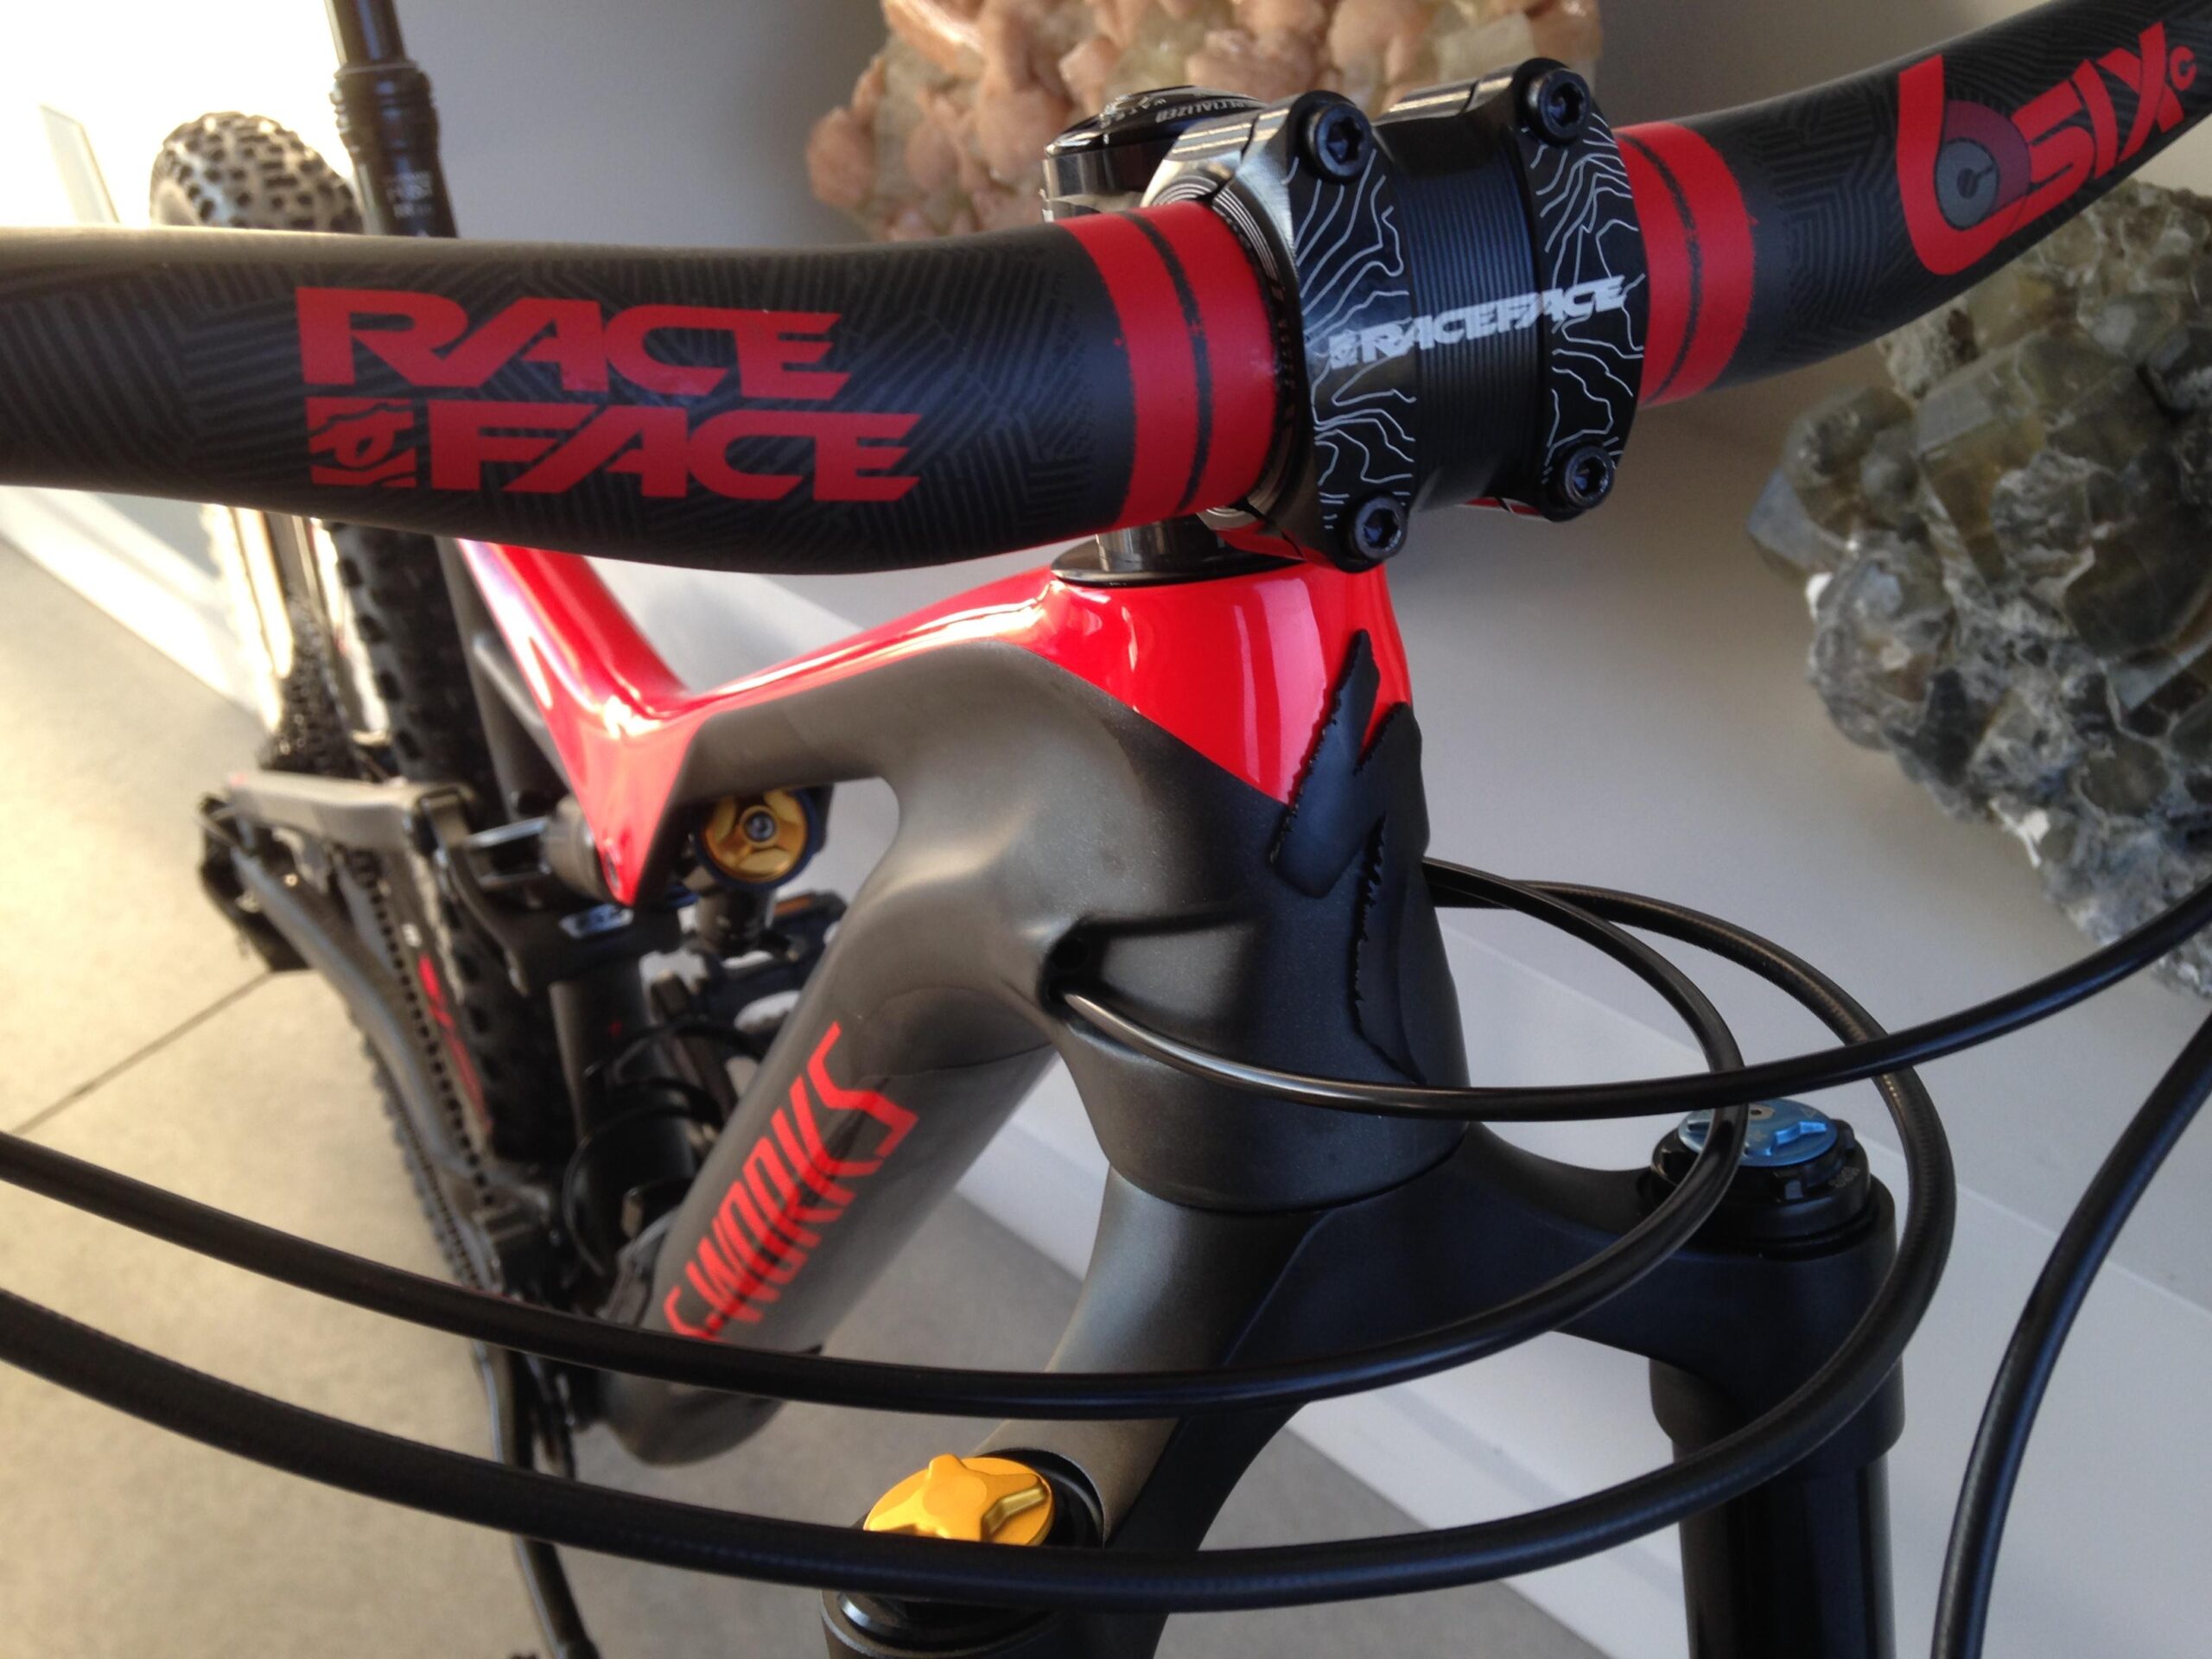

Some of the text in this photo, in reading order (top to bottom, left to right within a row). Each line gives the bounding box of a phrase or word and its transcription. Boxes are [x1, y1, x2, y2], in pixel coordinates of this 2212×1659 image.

[1156, 98, 1248, 124] PECIALIZED
[296, 287, 852, 400] RACE
[428, 399, 920, 501] FACE
